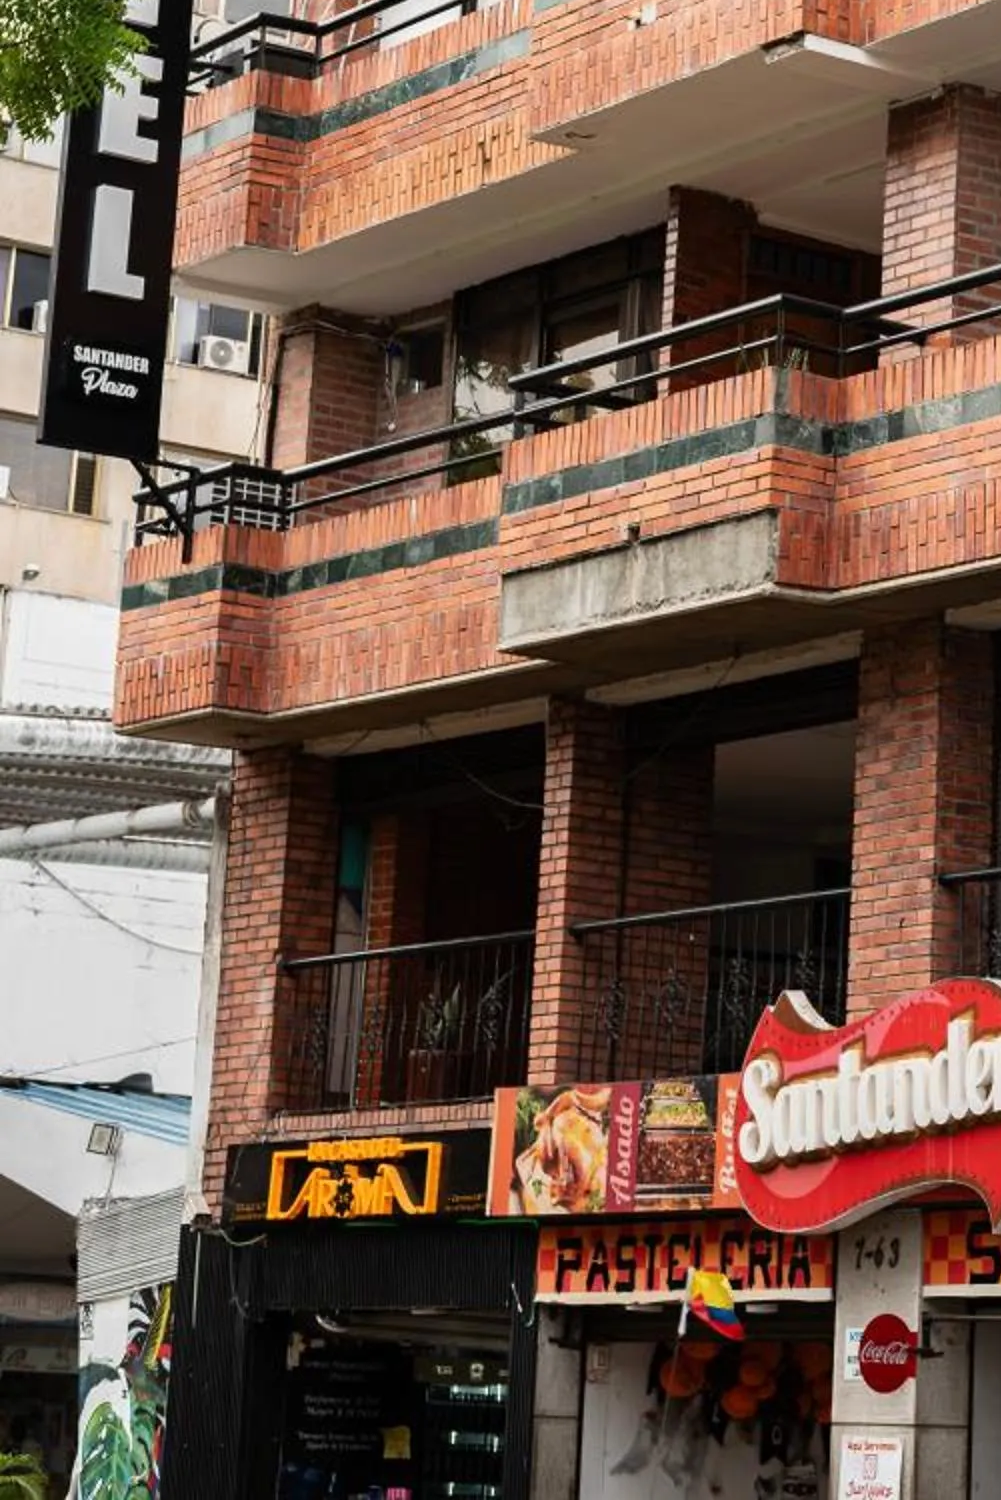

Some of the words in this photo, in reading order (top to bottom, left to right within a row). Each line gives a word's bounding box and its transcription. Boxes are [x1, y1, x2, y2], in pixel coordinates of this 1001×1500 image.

[73, 345, 149, 375] SANTANDER
[81, 367, 139, 399] Plaza
[609, 1096, 635, 1206] Asado
